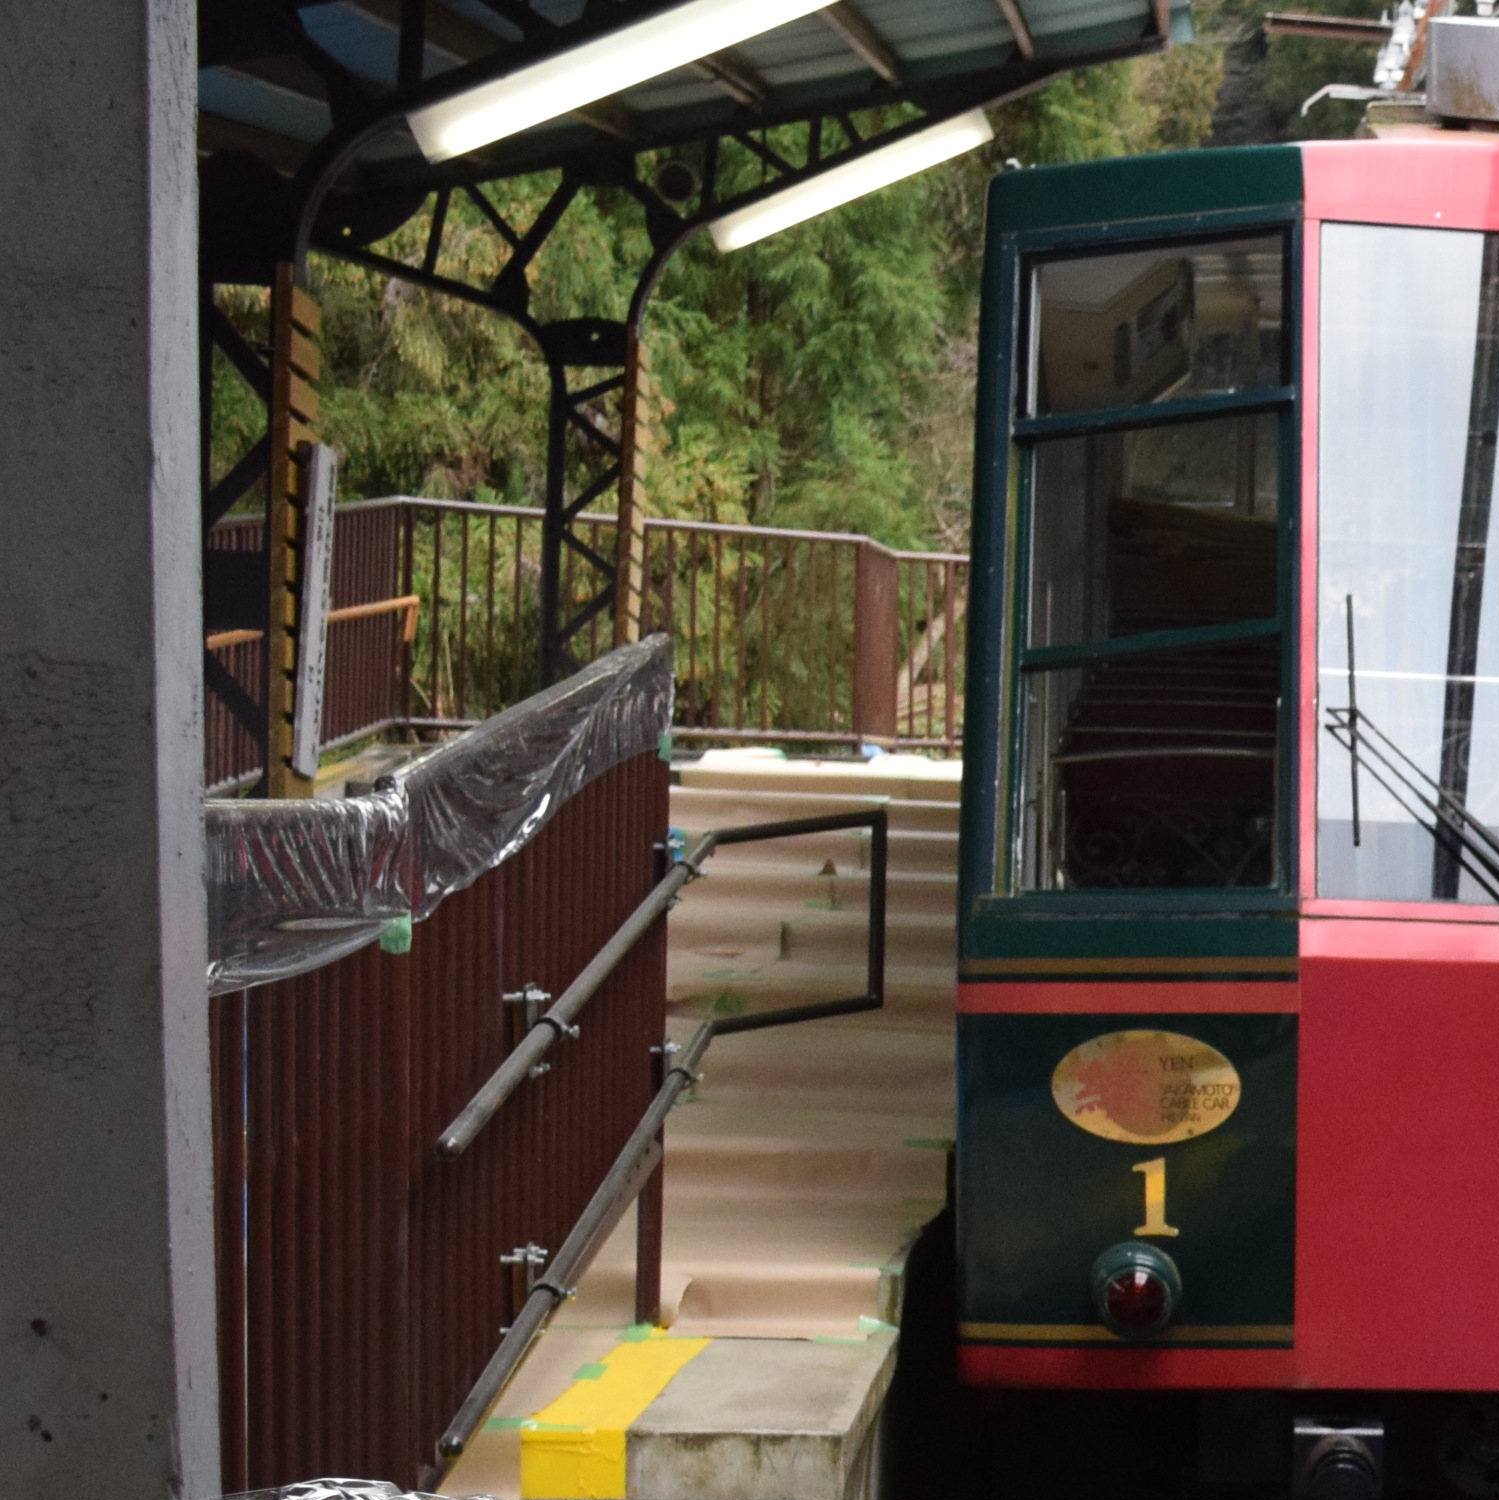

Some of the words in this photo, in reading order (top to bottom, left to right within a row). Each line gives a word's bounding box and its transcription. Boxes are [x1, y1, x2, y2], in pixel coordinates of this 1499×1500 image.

[1159, 1056, 1194, 1071] YEN
[1202, 1097, 1229, 1110] CAR
[1132, 1157, 1179, 1237] 1
